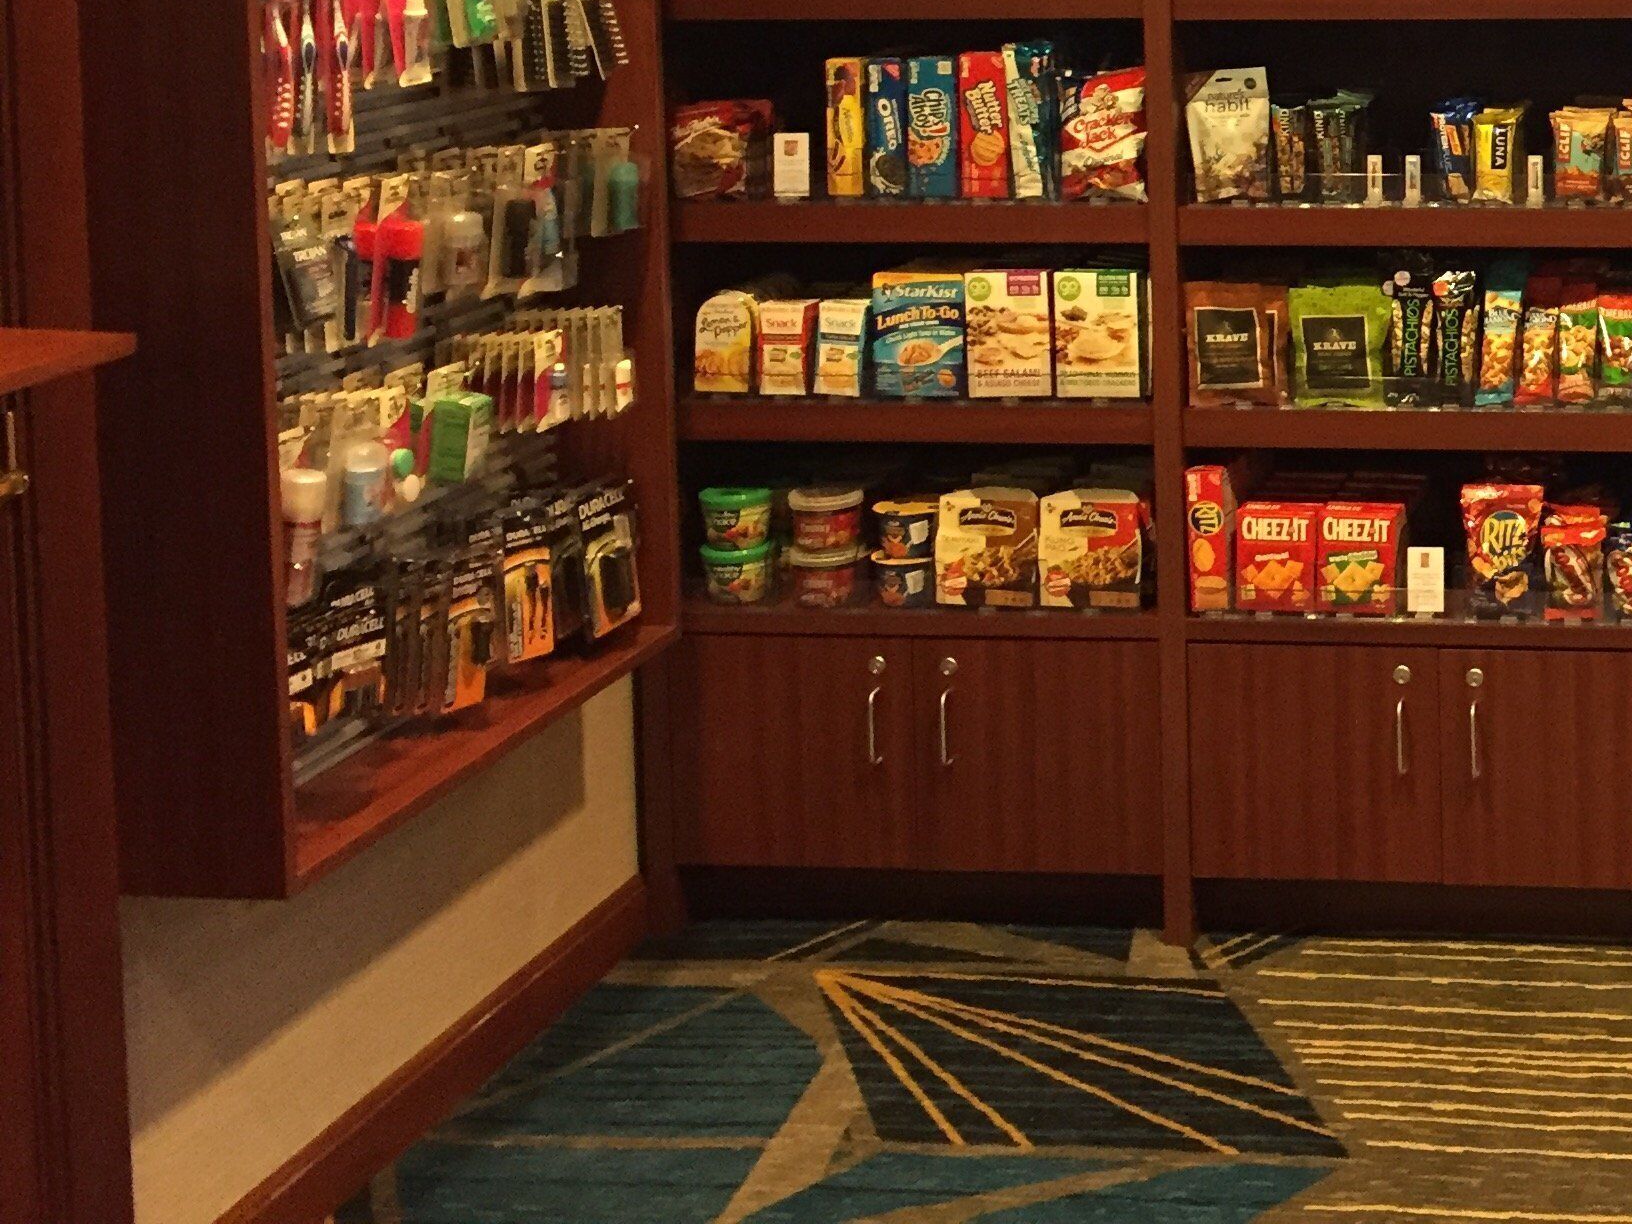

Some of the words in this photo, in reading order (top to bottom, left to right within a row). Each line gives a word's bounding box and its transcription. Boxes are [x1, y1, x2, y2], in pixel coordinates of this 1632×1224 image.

[965, 88, 993, 135] Butter
[977, 80, 1003, 128] Nutter
[1007, 81, 1033, 124] TREATS
[1205, 97, 1251, 113] habit
[877, 98, 897, 151] OREO
[1073, 111, 1134, 133] Cracker
[1280, 108, 1291, 136] KIND
[1313, 109, 1325, 140] KIND
[1082, 129, 1117, 149] Jack
[1494, 126, 1508, 167] LUNA
[1559, 122, 1572, 154] CLIF
[1619, 129, 1632, 158] CLIF
[893, 284, 959, 299] StarKist
[766, 317, 798, 329] Snack
[824, 317, 856, 329] Snack
[877, 307, 922, 330] Lunch
[921, 305, 960, 321] To-Go
[1206, 332, 1249, 343] KRAVE
[1313, 340, 1357, 351] KRAVE
[1404, 298, 1421, 377] PISTACHIOS
[1445, 308, 1460, 386] PISTACHIOS
[578, 488, 626, 521] DURACELL
[1195, 503, 1221, 534] RITZ
[1241, 515, 1310, 542] CHEEZ-IT
[1322, 516, 1391, 543] CHEEZ-IT
[1482, 518, 1527, 557] RITZ
[336, 616, 386, 642] DURACELL
